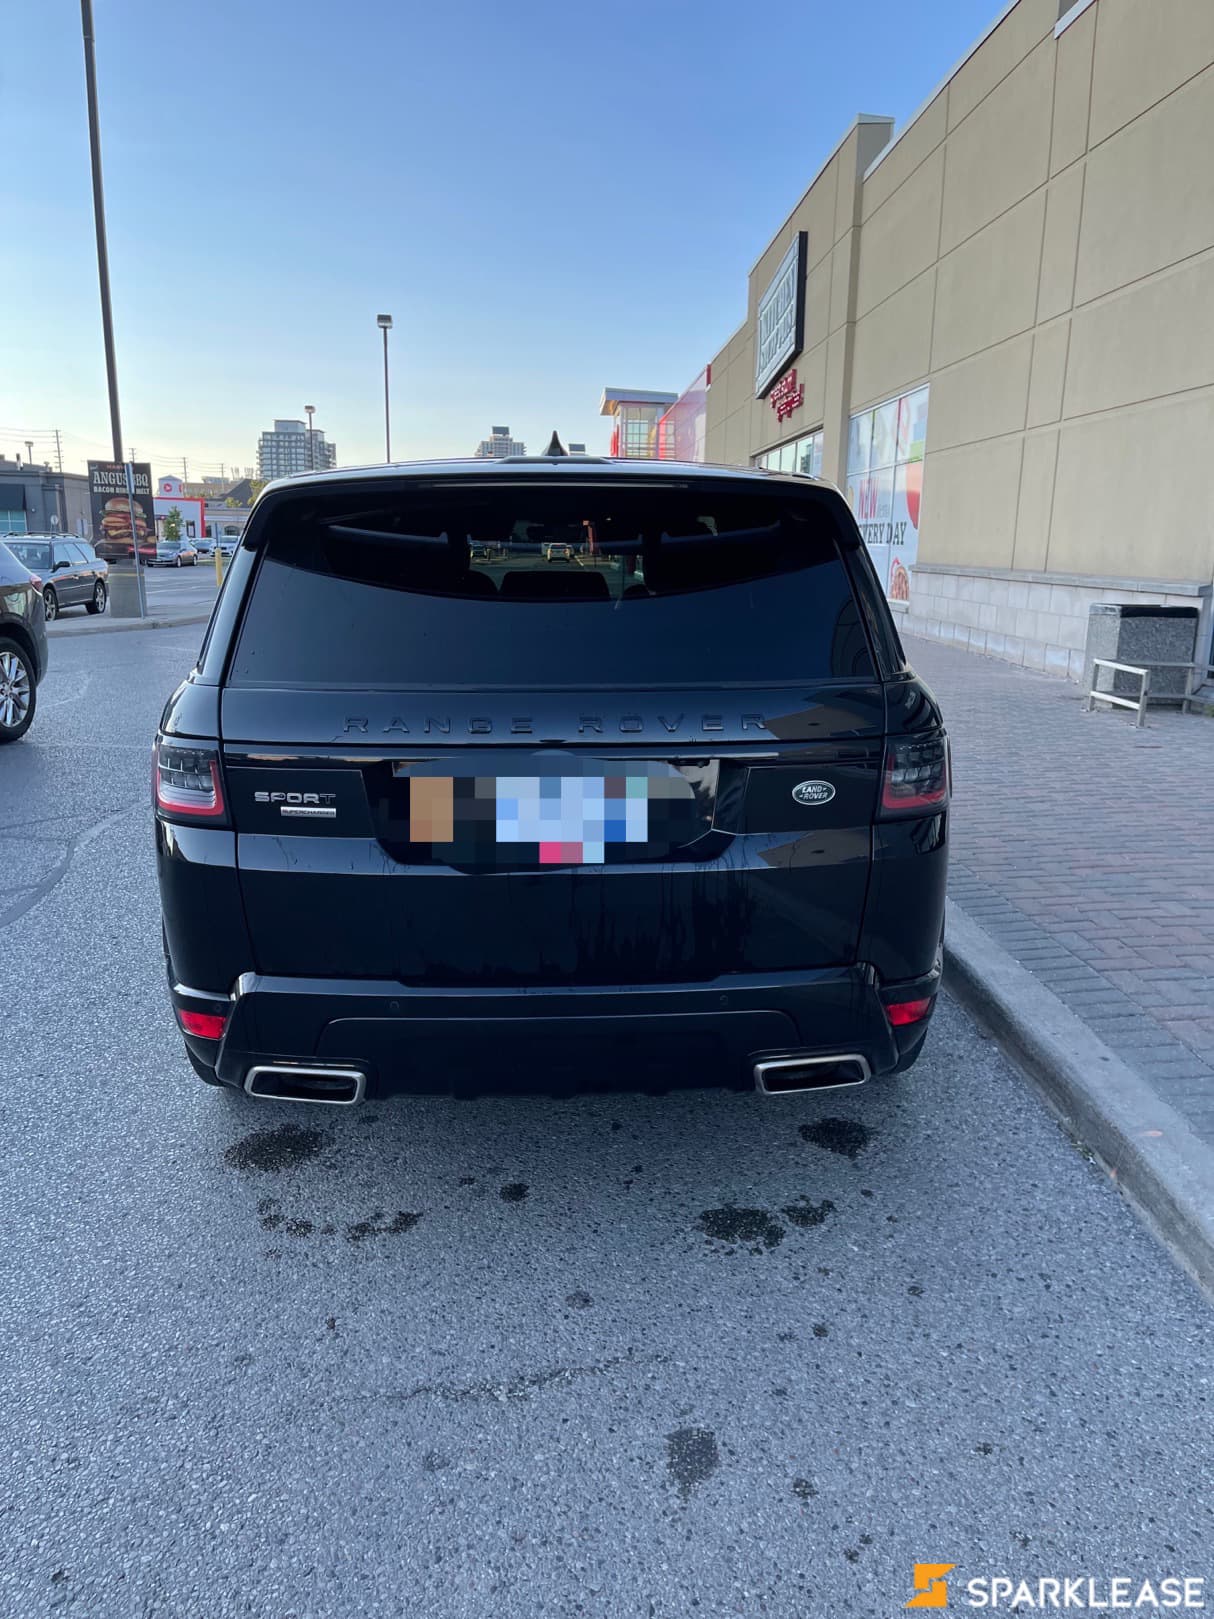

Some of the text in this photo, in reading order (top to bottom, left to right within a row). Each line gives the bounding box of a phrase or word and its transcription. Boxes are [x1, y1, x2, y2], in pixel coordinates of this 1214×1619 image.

[93, 471, 149, 487] ANGUS BQ
[859, 521, 907, 545] VERY DAY
[343, 713, 767, 734] RANGE ROVER
[802, 785, 823, 793] LAND
[803, 792, 828, 800] ROVER
[254, 791, 337, 804] SPORT
